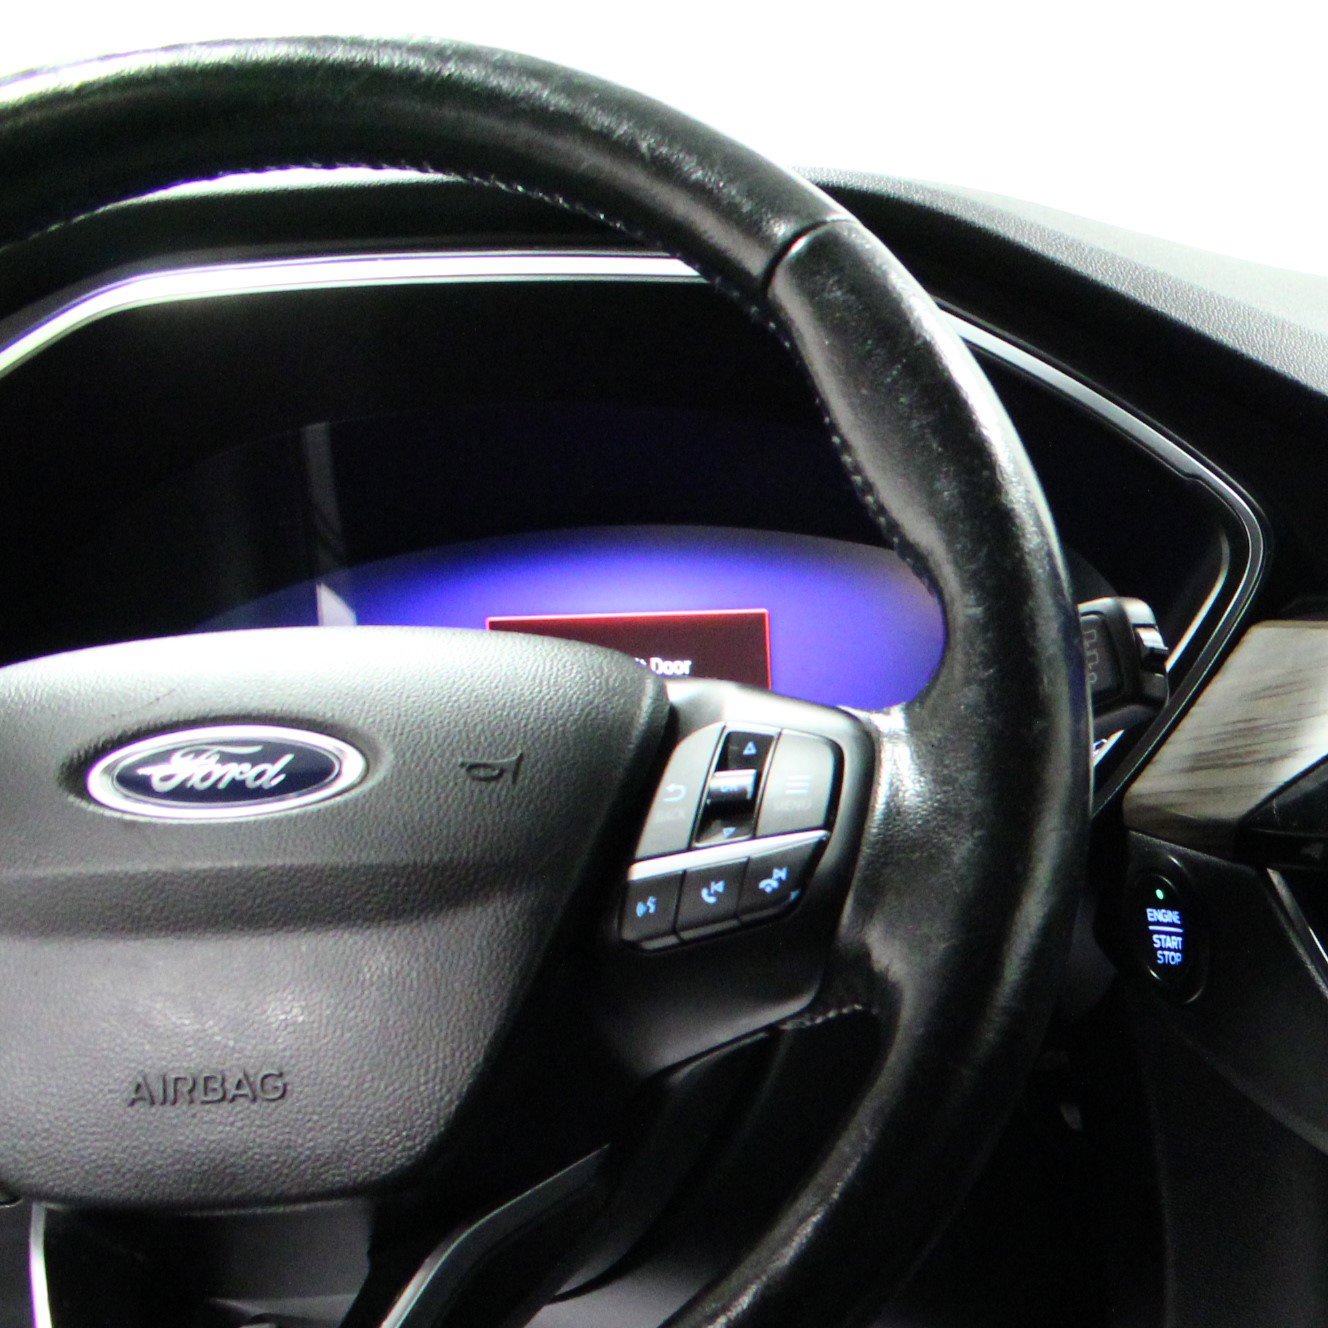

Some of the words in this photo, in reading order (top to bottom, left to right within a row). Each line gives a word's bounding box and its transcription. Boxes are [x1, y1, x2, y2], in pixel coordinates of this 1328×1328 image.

[649, 657, 692, 675] Door
[136, 744, 295, 793] Ford
[1146, 908, 1181, 924] ENGINE
[1152, 934, 1183, 949] START
[1156, 951, 1182, 965] STOP
[128, 1068, 288, 1108] AIRBAG
